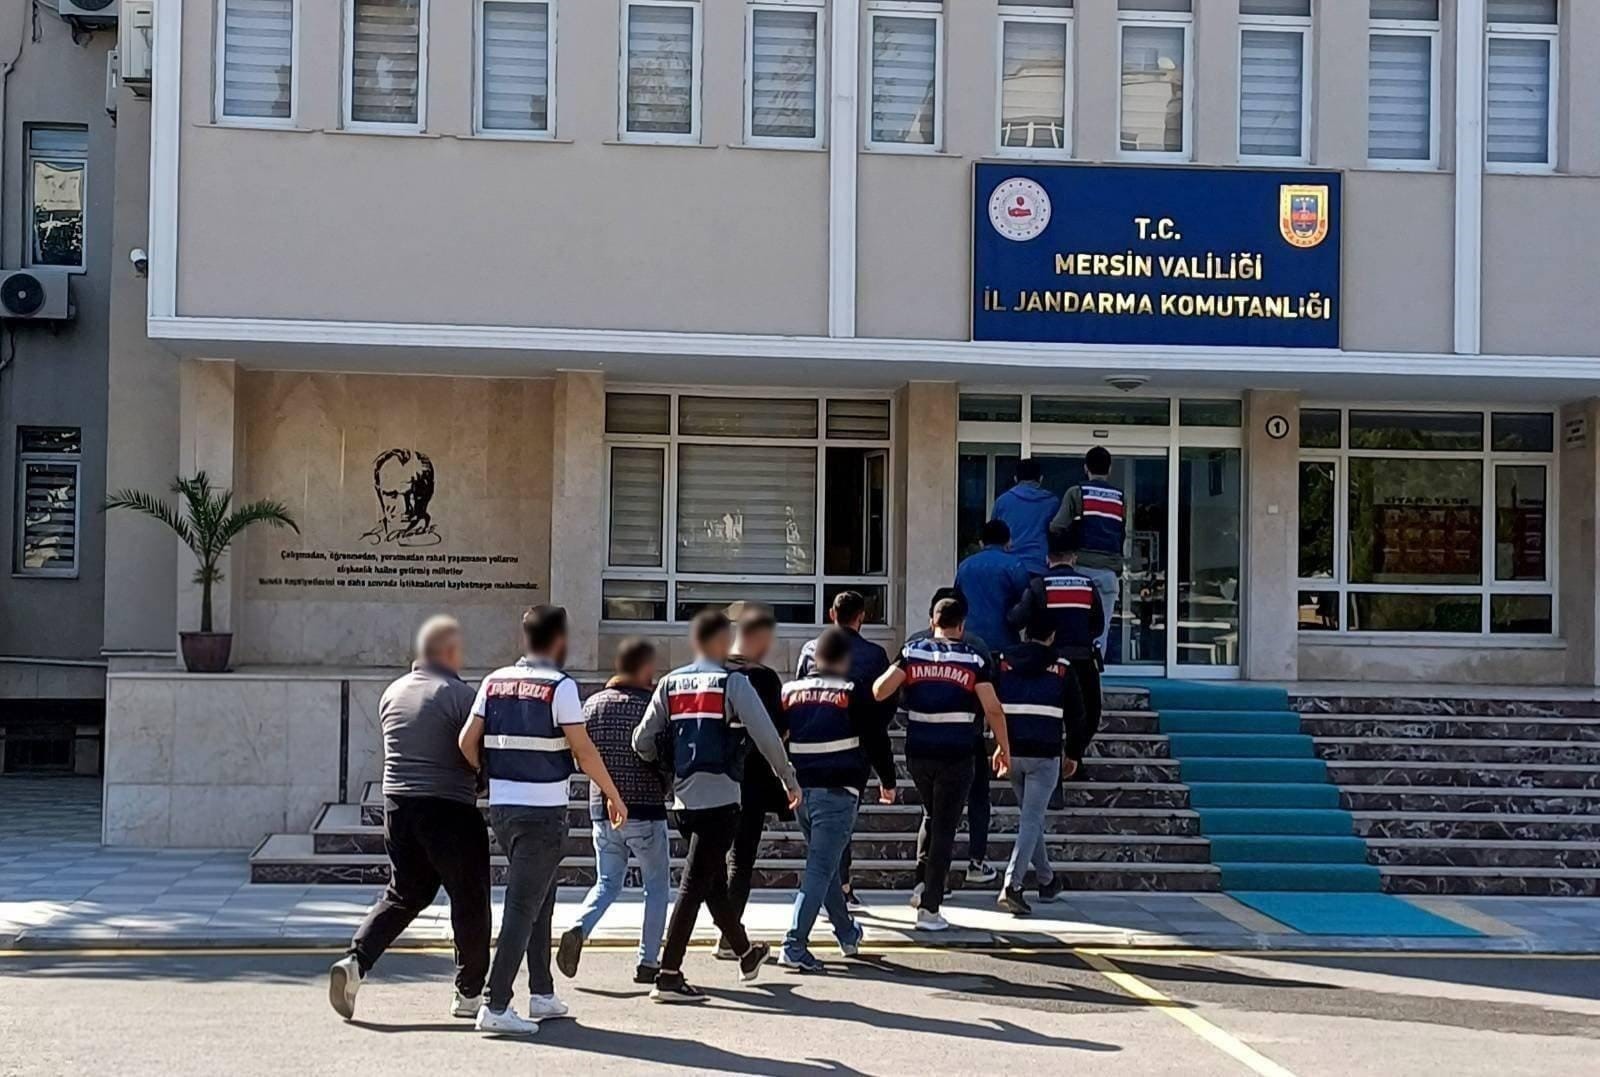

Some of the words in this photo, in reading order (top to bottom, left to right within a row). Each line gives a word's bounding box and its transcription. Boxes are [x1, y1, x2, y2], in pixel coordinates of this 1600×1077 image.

[1134, 218, 1181, 241] T.C.
[1055, 250, 1152, 277] MERSİN
[1158, 252, 1263, 281] VALİLİĞİ
[984, 286, 1006, 312] İL
[1013, 291, 1153, 316] JANDARMA
[1160, 292, 1330, 319] KOMUTANLIĞI
[1273, 421, 1280, 434] 1
